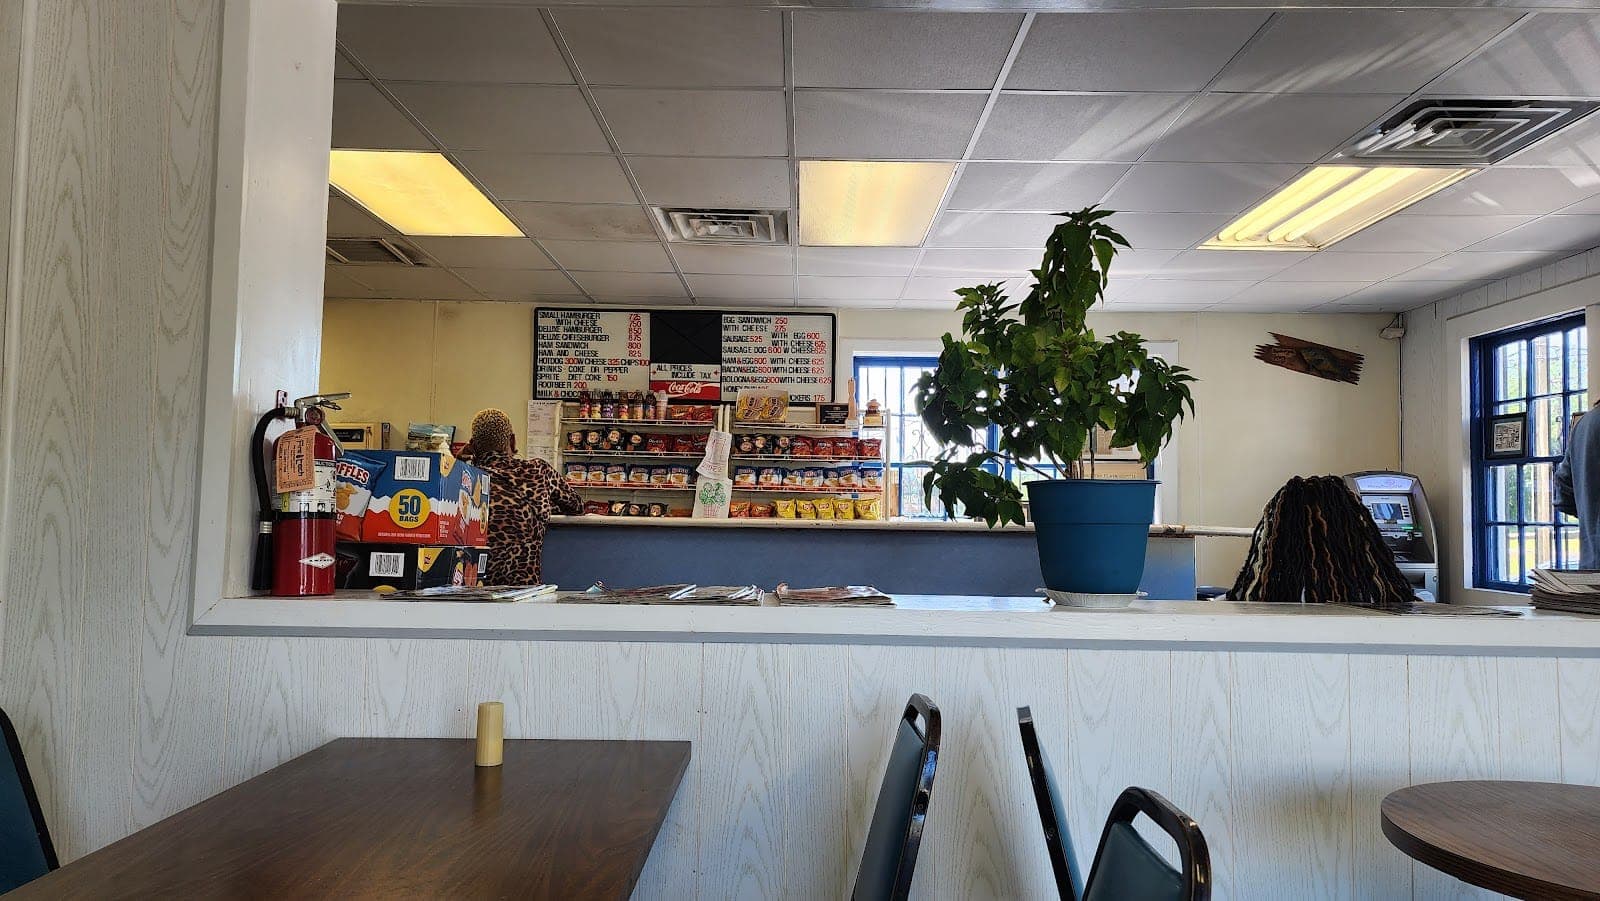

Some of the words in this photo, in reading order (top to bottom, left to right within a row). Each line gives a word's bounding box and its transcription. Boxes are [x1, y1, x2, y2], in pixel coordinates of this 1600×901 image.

[671, 371, 695, 379] INCLUDE
[336, 462, 369, 484] FFLES
[398, 494, 421, 516] 50
